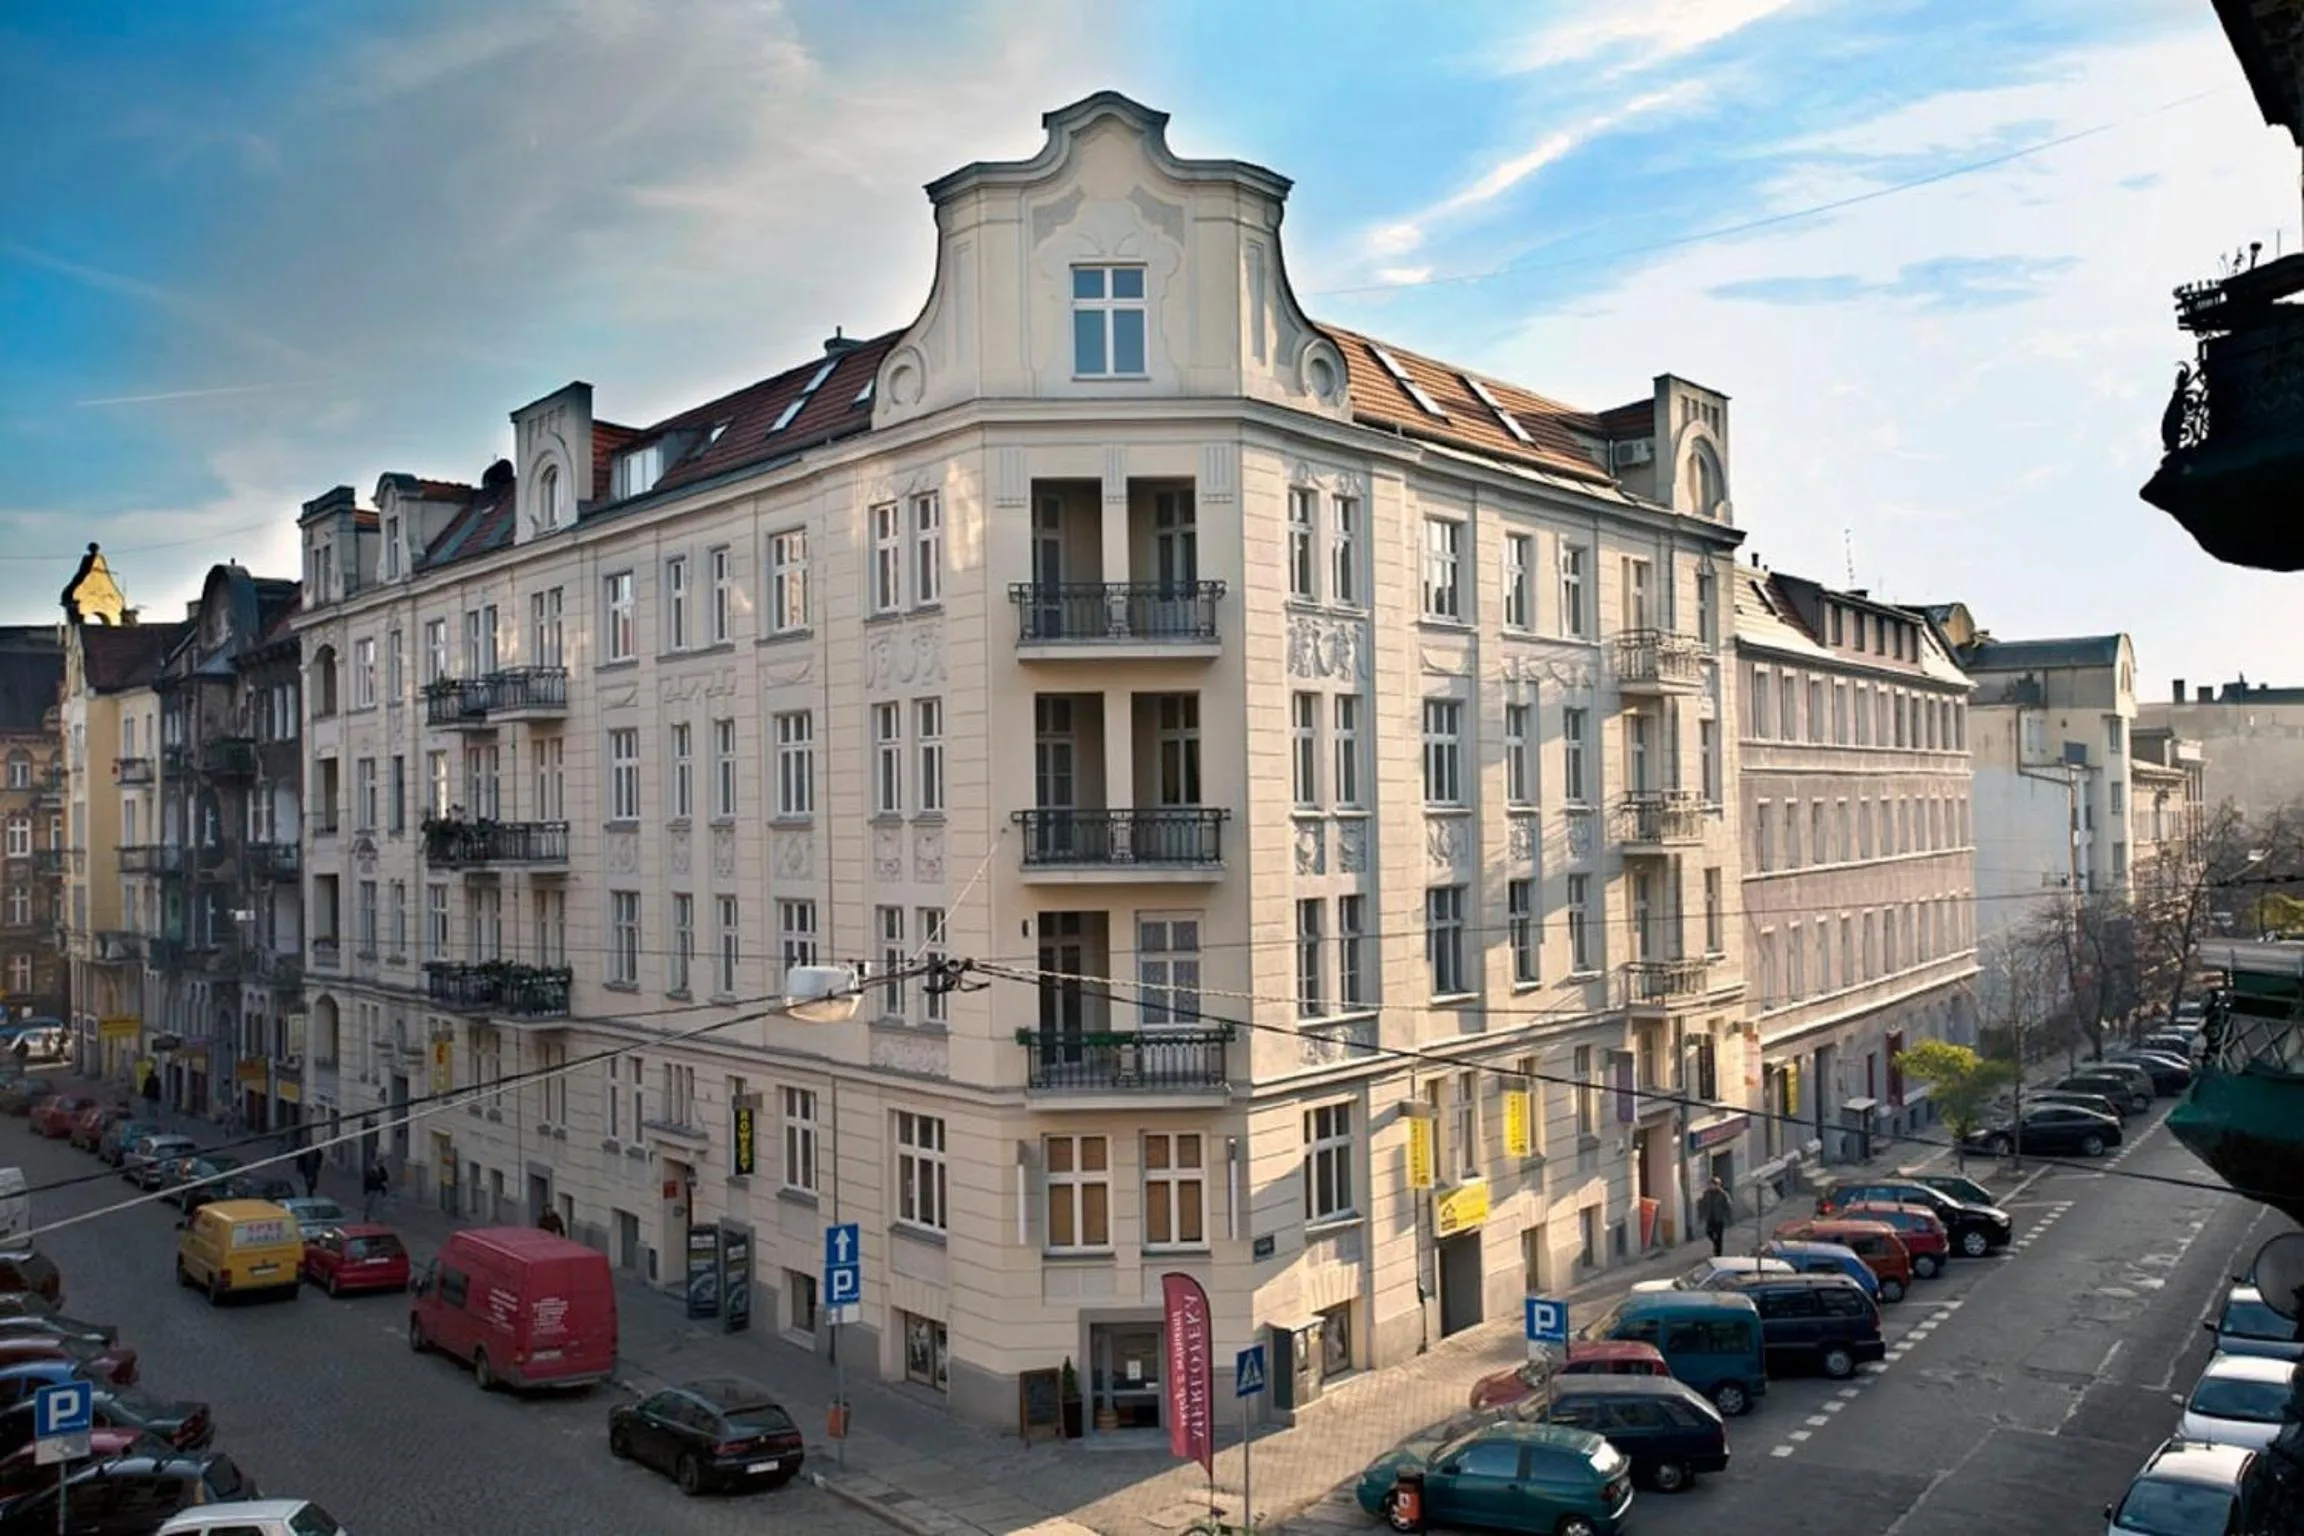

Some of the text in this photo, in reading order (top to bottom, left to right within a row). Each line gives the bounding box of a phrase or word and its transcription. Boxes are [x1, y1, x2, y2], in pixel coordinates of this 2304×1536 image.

[833, 1269, 853, 1301] P
[1534, 1303, 1557, 1335] P
[48, 1389, 80, 1432] P
